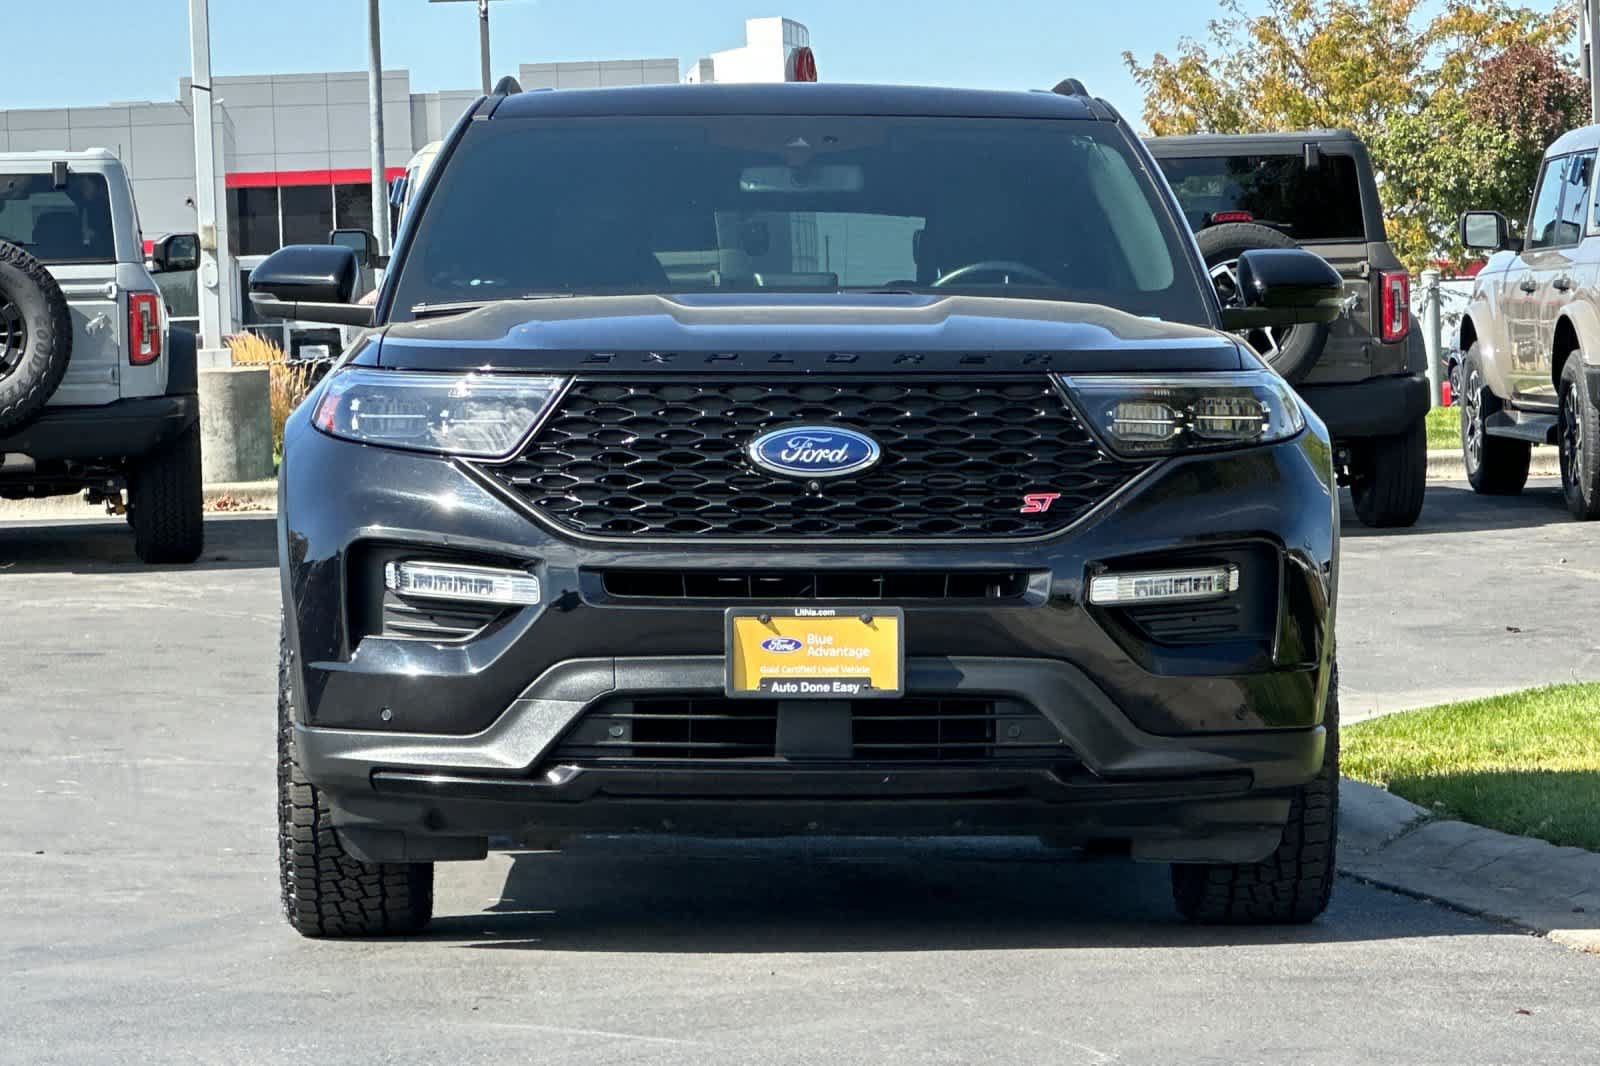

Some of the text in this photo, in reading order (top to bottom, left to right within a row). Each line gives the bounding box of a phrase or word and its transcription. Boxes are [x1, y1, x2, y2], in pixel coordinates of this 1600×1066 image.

[781, 436, 848, 463] Ford
[1020, 493, 1061, 513] ST
[807, 633, 832, 644] Blue
[807, 646, 870, 659] Advantage
[781, 665, 816, 674] Certified
[818, 665, 840, 674] Used
[841, 665, 870, 674] Vehicle
[771, 682, 860, 695] Auto Done Easy
